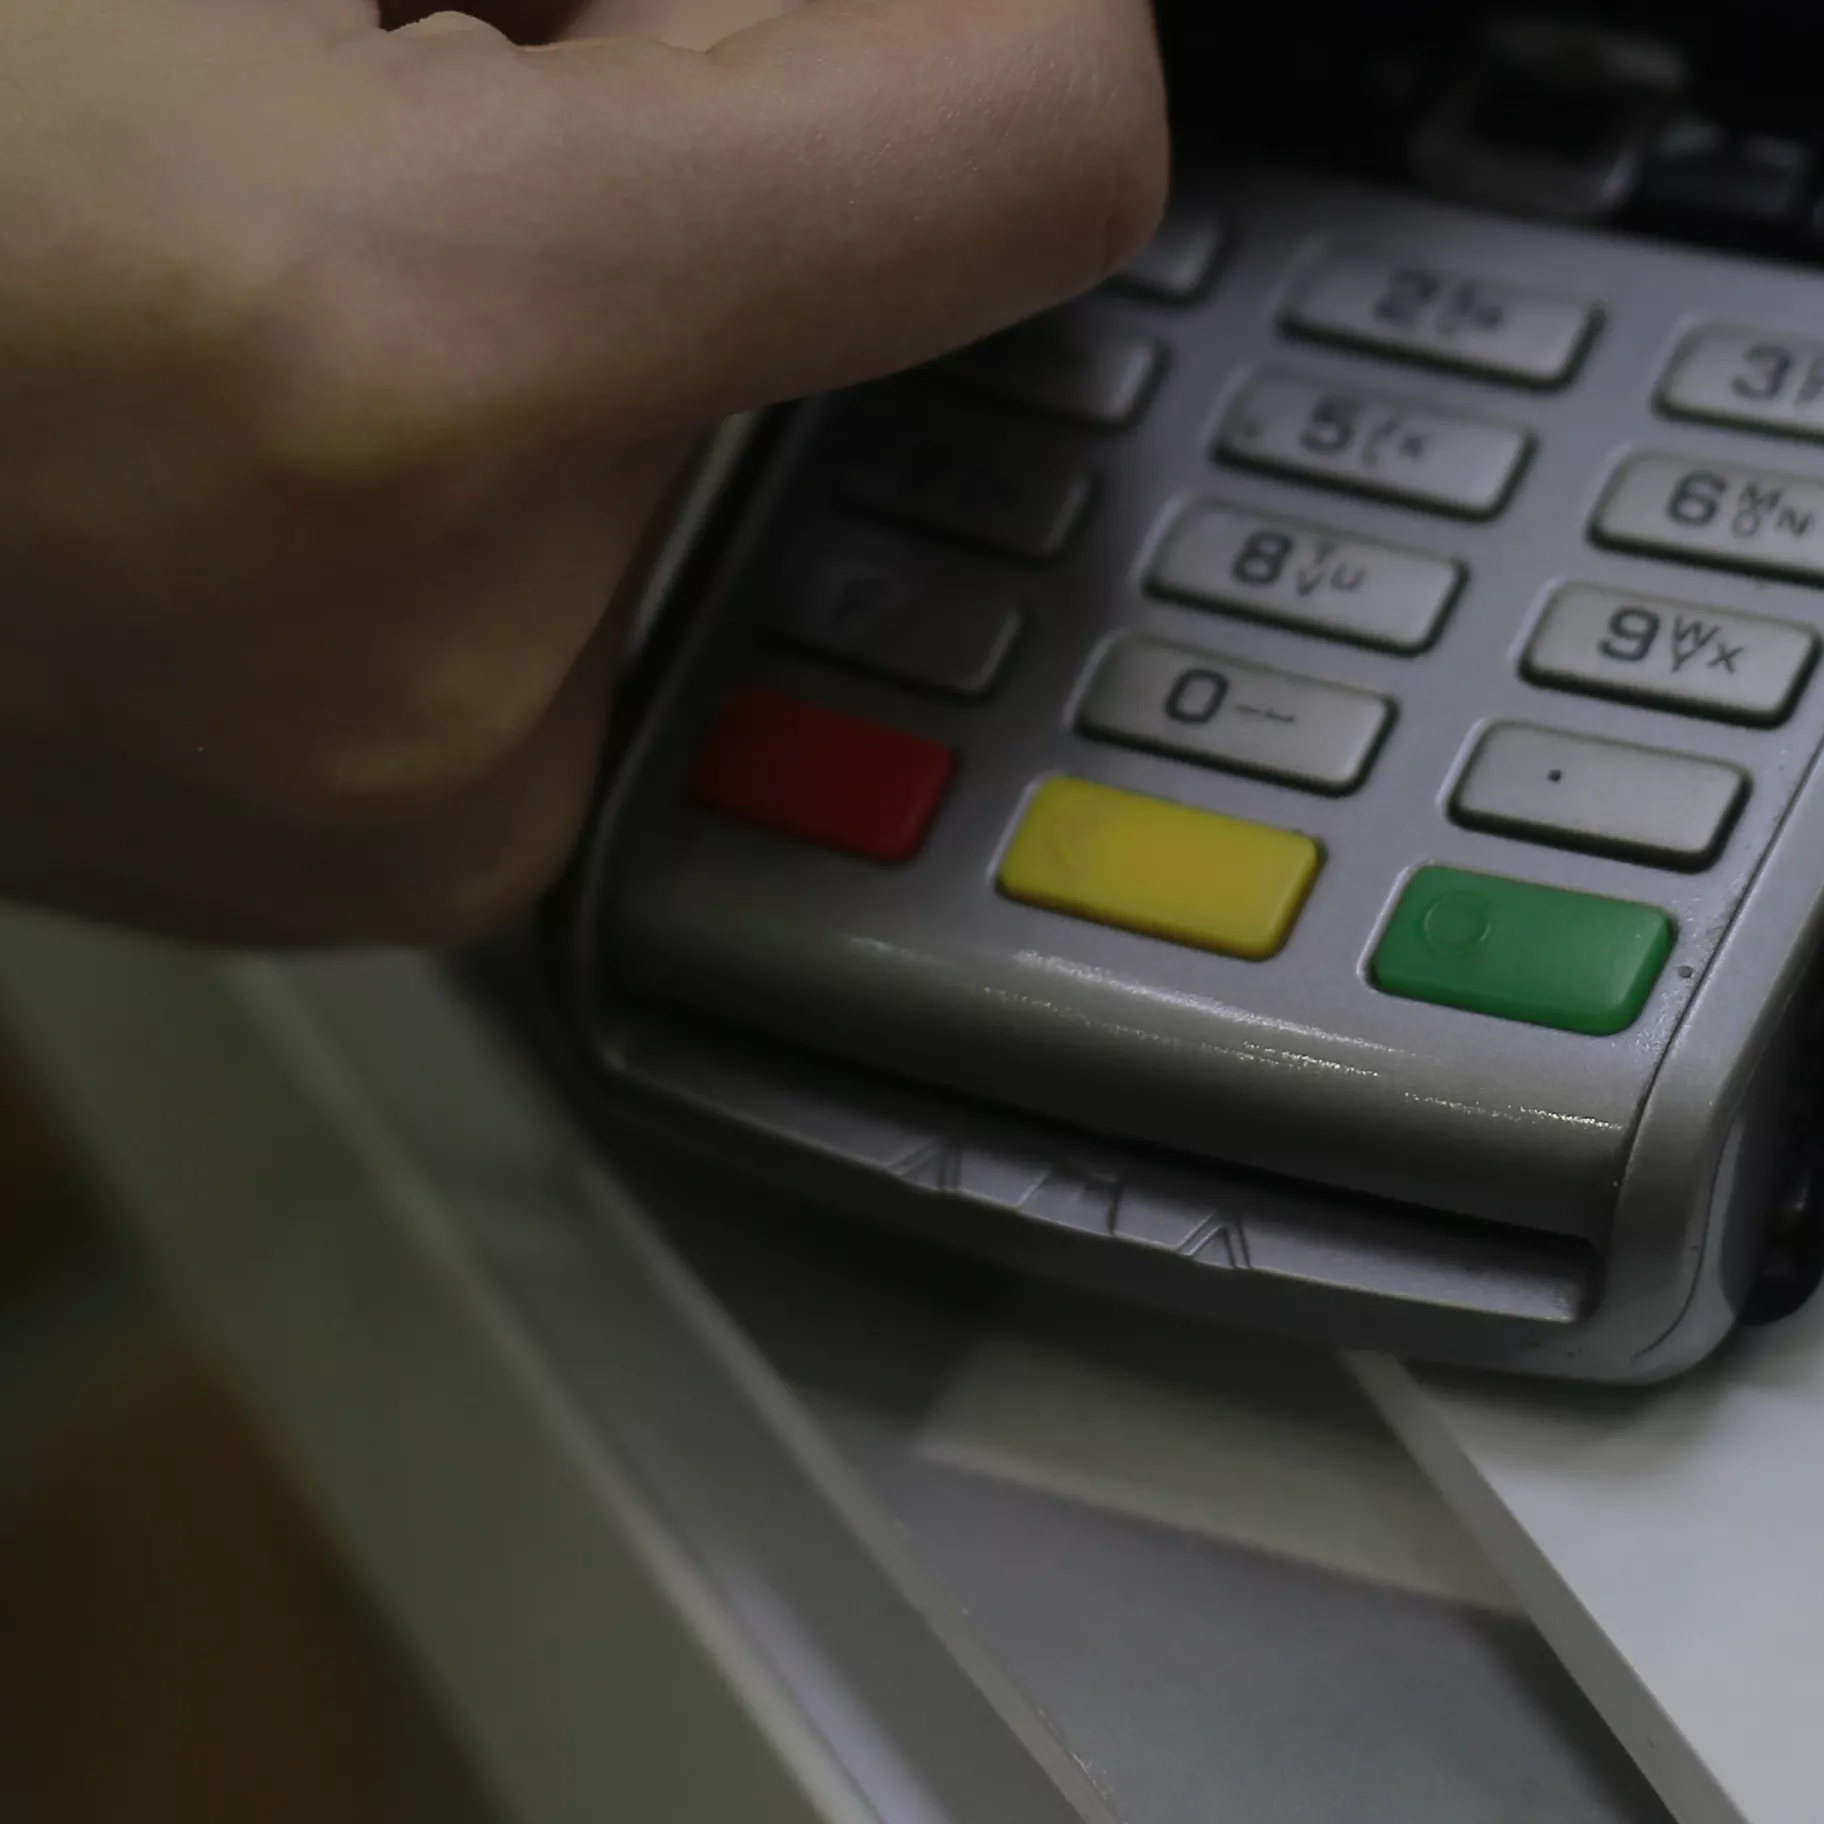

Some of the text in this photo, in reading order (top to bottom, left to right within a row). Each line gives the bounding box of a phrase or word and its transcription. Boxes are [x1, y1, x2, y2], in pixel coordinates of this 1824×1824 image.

[1375, 268, 1438, 321] 2
[1730, 340, 1792, 402] 3
[1301, 394, 1358, 455] 5
[1666, 470, 1727, 527] 6
[1231, 530, 1294, 587] 8
[1596, 603, 1662, 662] 9
[1164, 667, 1229, 725] 0
